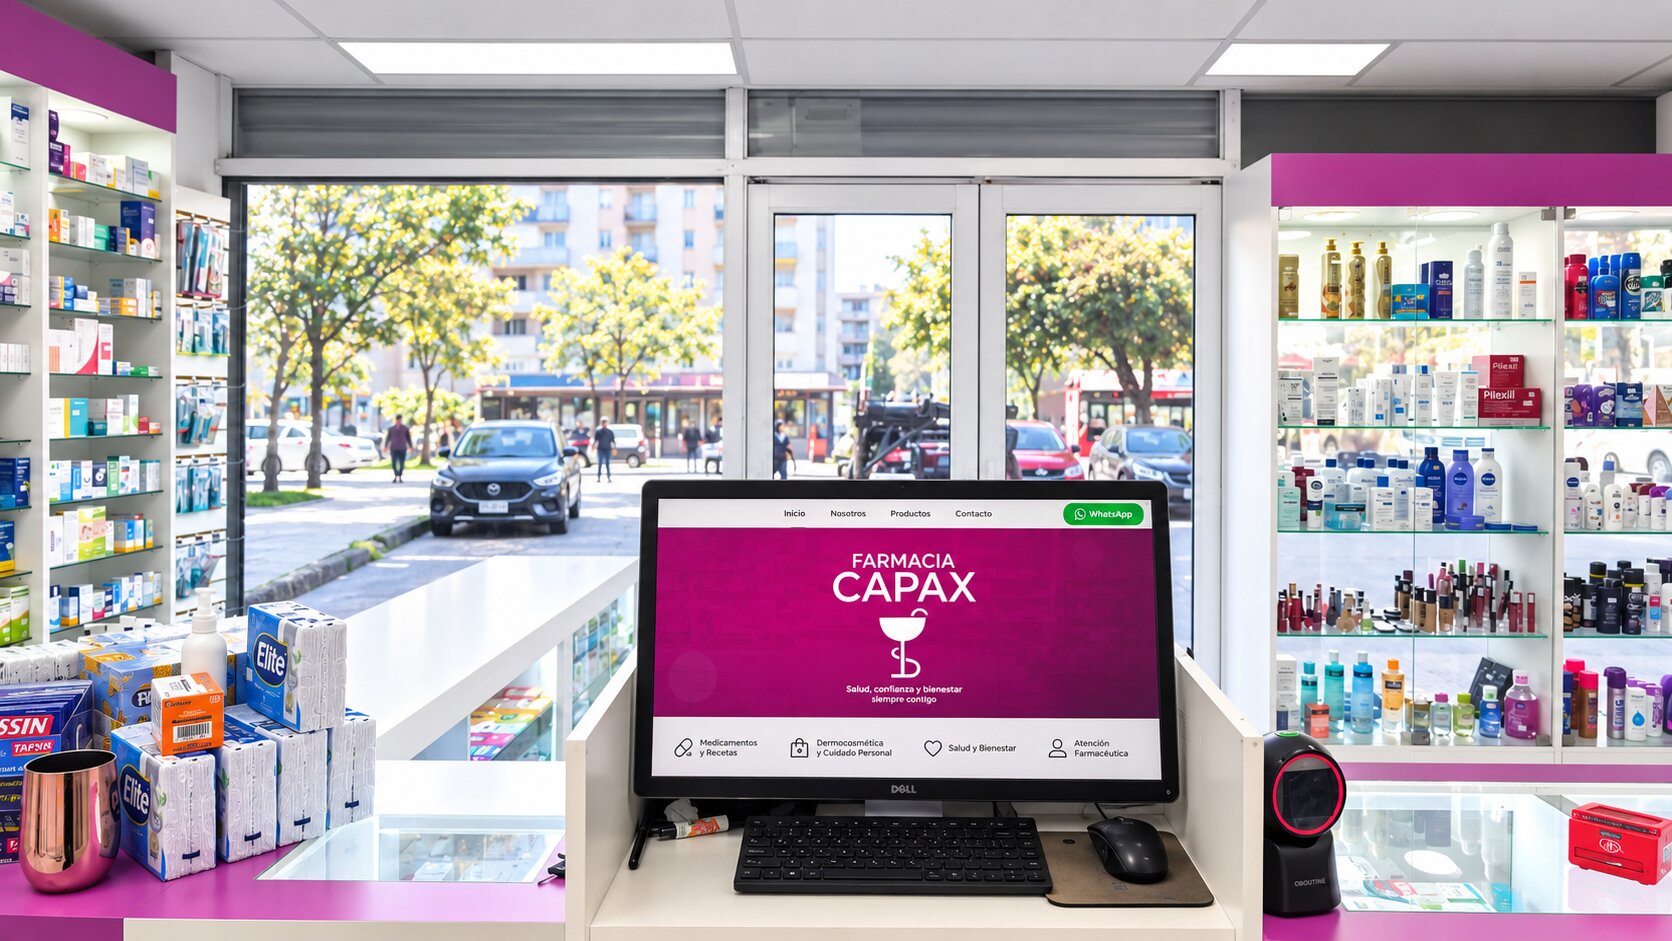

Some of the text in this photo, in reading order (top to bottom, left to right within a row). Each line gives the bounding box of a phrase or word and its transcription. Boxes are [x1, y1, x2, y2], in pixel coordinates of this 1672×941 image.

[783, 509, 993, 518] Inicio Nosotros Productos Contacto
[1089, 510, 1133, 520] WhatsApp
[852, 553, 956, 569] FARMACIA
[832, 571, 977, 603] CAPAX
[256, 641, 286, 677] Elite
[846, 685, 963, 695] Salud, confianza y bienestar
[871, 695, 938, 705] siempre contigo
[700, 739, 758, 747] Medicamentos
[816, 739, 884, 747] Dermocosmética
[1074, 739, 1110, 747] Atención
[700, 749, 738, 758] y Recetas
[816, 749, 893, 758] y Cuidado Personal
[948, 744, 1017, 754] Salud y Bienestar
[1074, 749, 1129, 757] Farmacéutica
[123, 774, 150, 815] Elite
